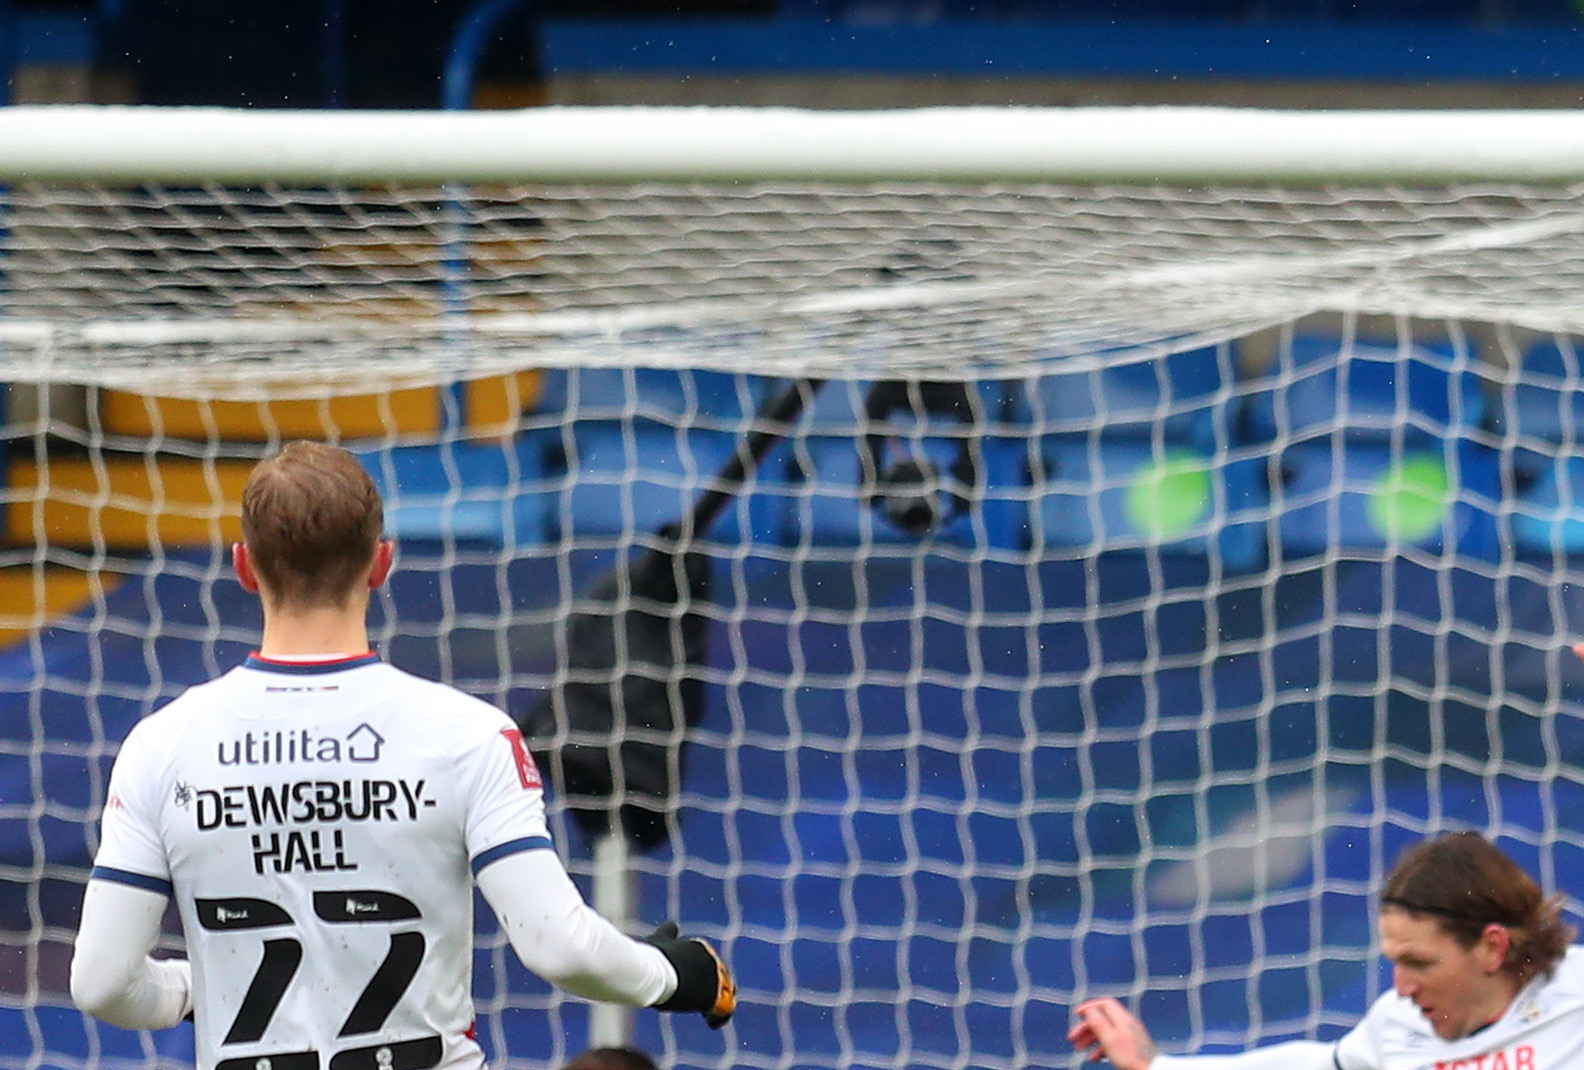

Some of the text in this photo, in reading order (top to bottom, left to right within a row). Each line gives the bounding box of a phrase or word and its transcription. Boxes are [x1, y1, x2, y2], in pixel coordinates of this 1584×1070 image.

[217, 730, 342, 767] utilita
[196, 779, 437, 831] DEWSBURY-
[251, 829, 358, 874] HALL
